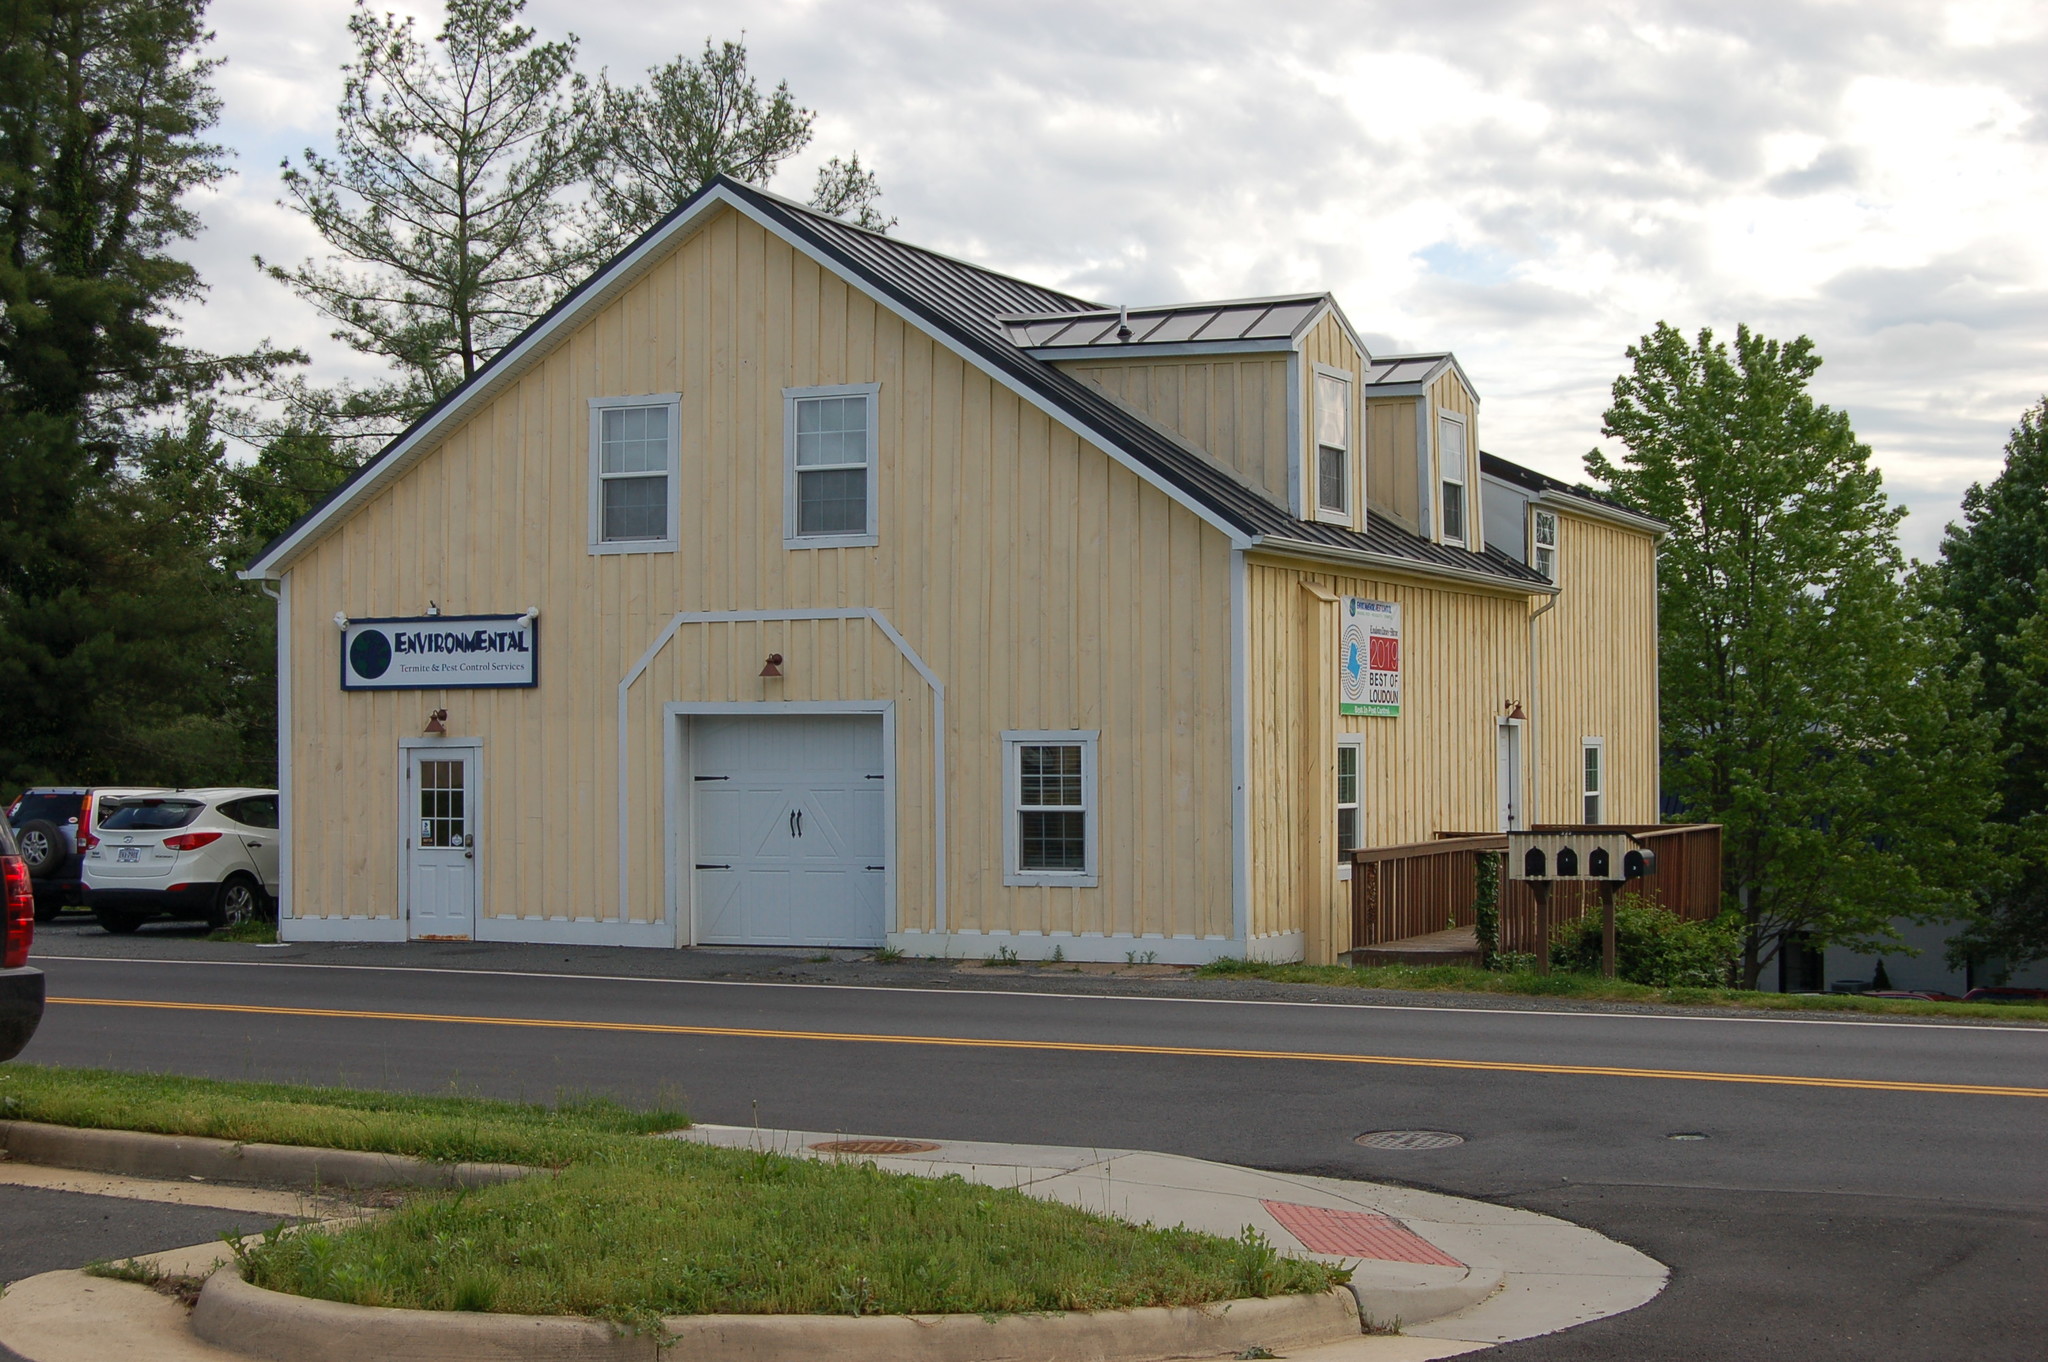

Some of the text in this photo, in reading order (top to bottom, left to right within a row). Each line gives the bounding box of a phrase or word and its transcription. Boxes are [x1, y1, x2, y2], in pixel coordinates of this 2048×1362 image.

[394, 630, 529, 654] ENVIRONMENTAL
[1370, 638, 1398, 669] 2019
[400, 662, 525, 673] Termite & Pest Control Services
[1369, 672, 1398, 688] BEST OF
[1369, 689, 1399, 704] LOUDOUN
